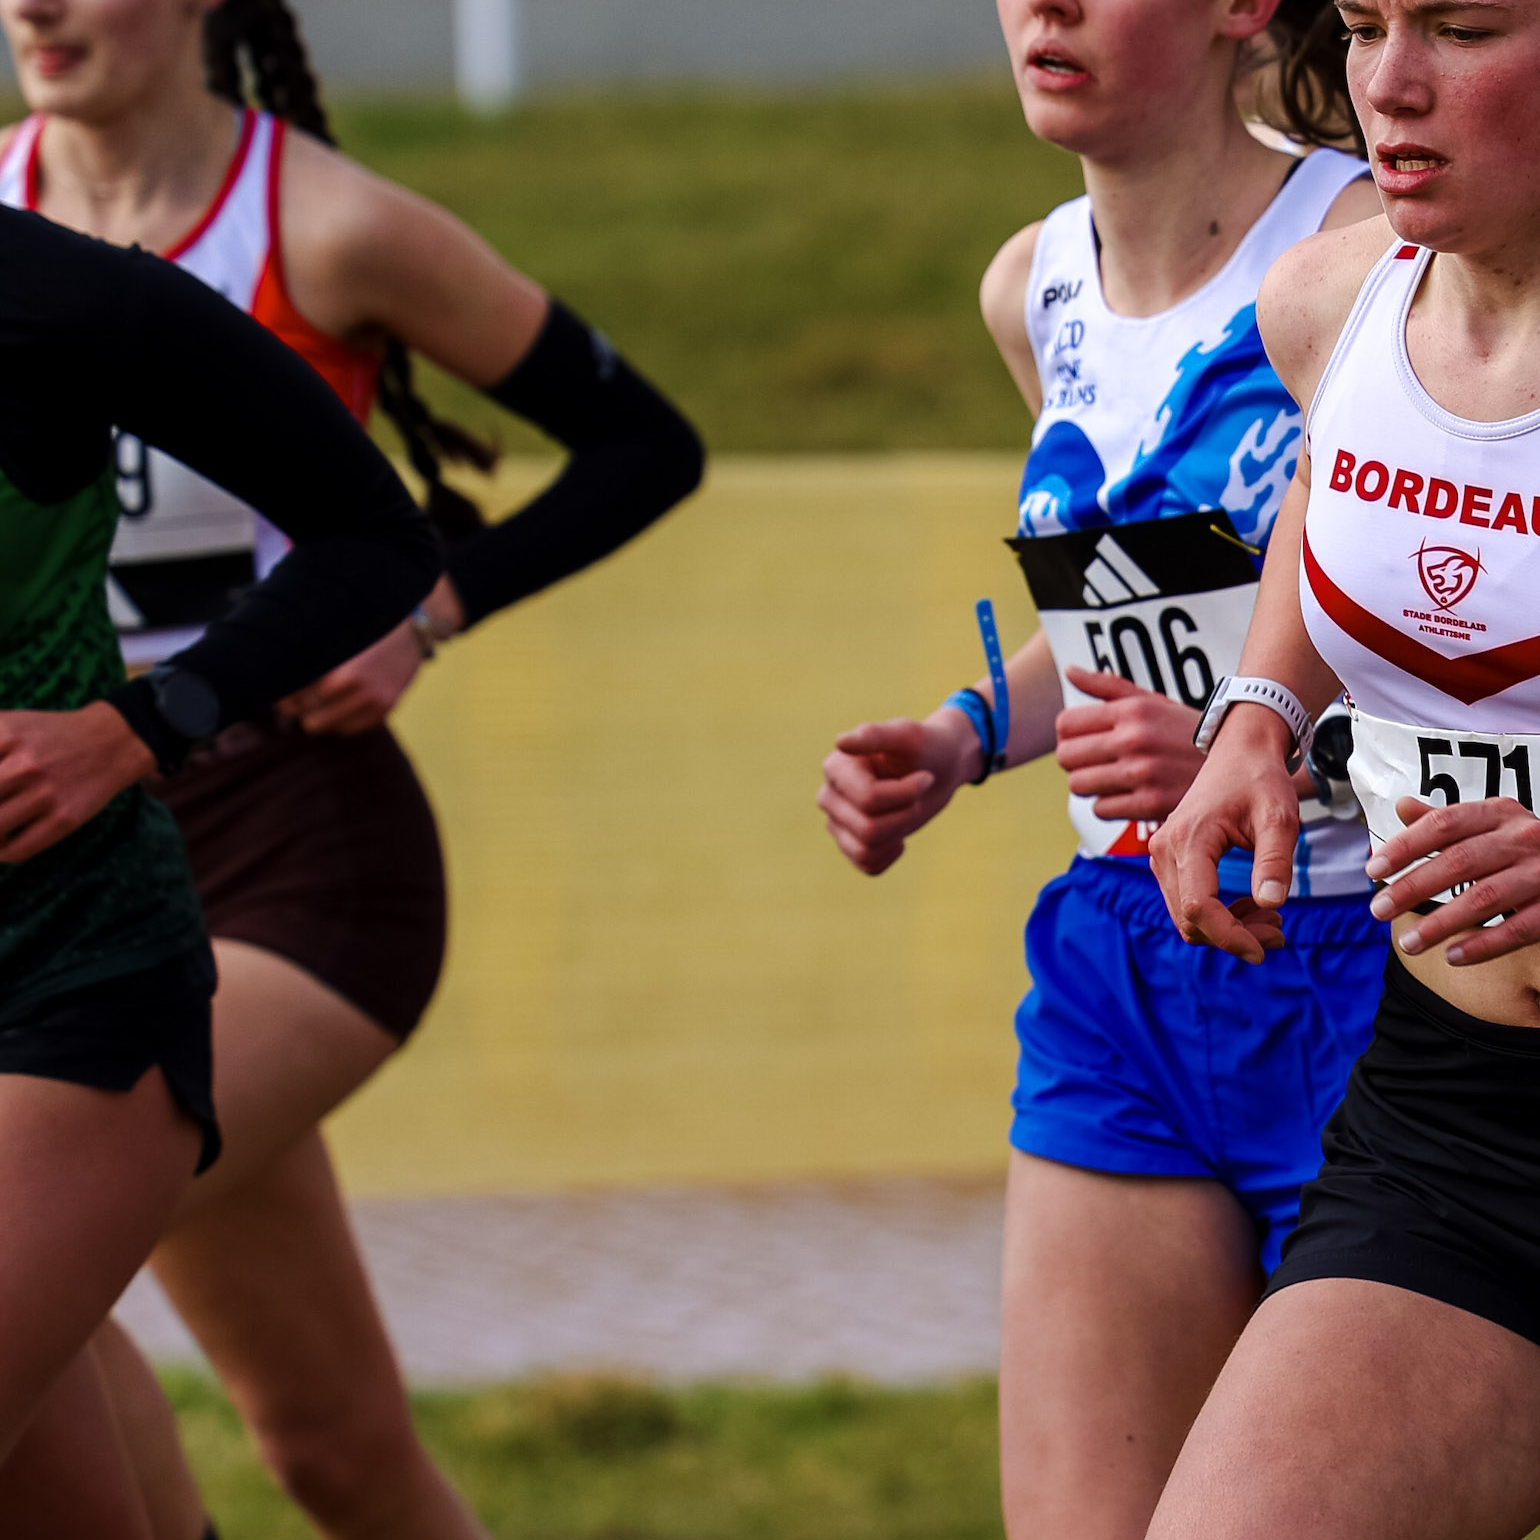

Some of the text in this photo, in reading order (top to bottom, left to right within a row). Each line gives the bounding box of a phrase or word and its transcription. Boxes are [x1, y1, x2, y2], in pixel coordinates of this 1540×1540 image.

[1402, 609, 1487, 632] STADE BORDELAIS
[1418, 624, 1471, 641] ATHLETISME
[1416, 736, 1534, 815] 571
